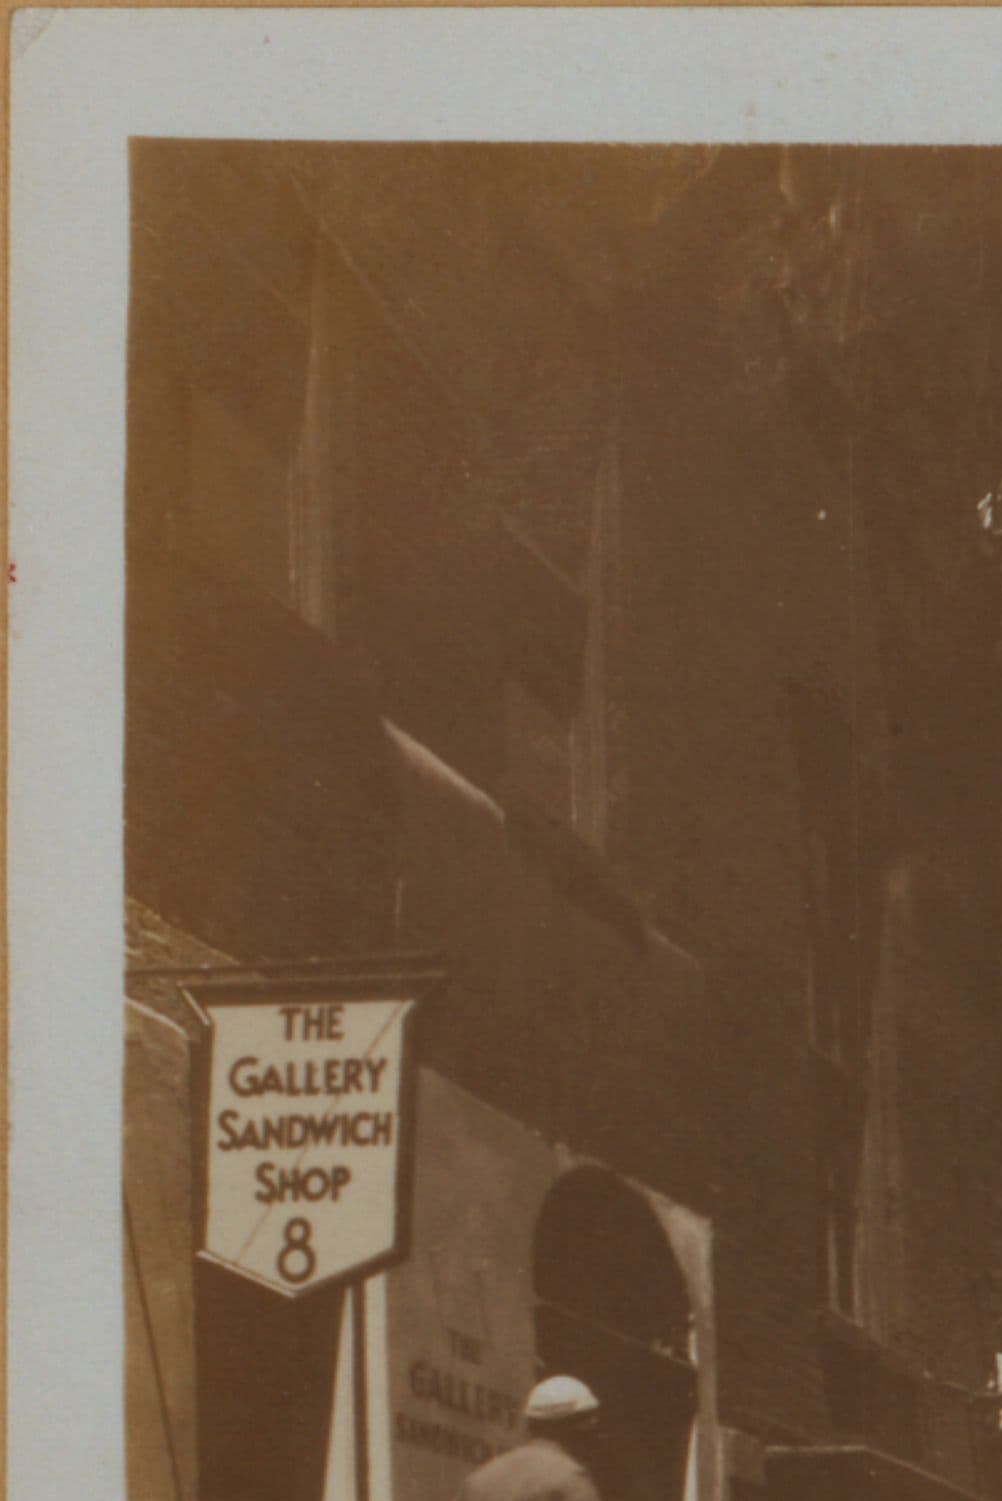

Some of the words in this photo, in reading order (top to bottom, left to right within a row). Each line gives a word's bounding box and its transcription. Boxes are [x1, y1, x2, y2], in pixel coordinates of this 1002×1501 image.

[279, 1005, 346, 1043] THE
[228, 1056, 388, 1099] GALLERY
[216, 1109, 393, 1152] SANDWICH
[254, 1161, 352, 1205] SHOP
[275, 1216, 318, 1285] 8
